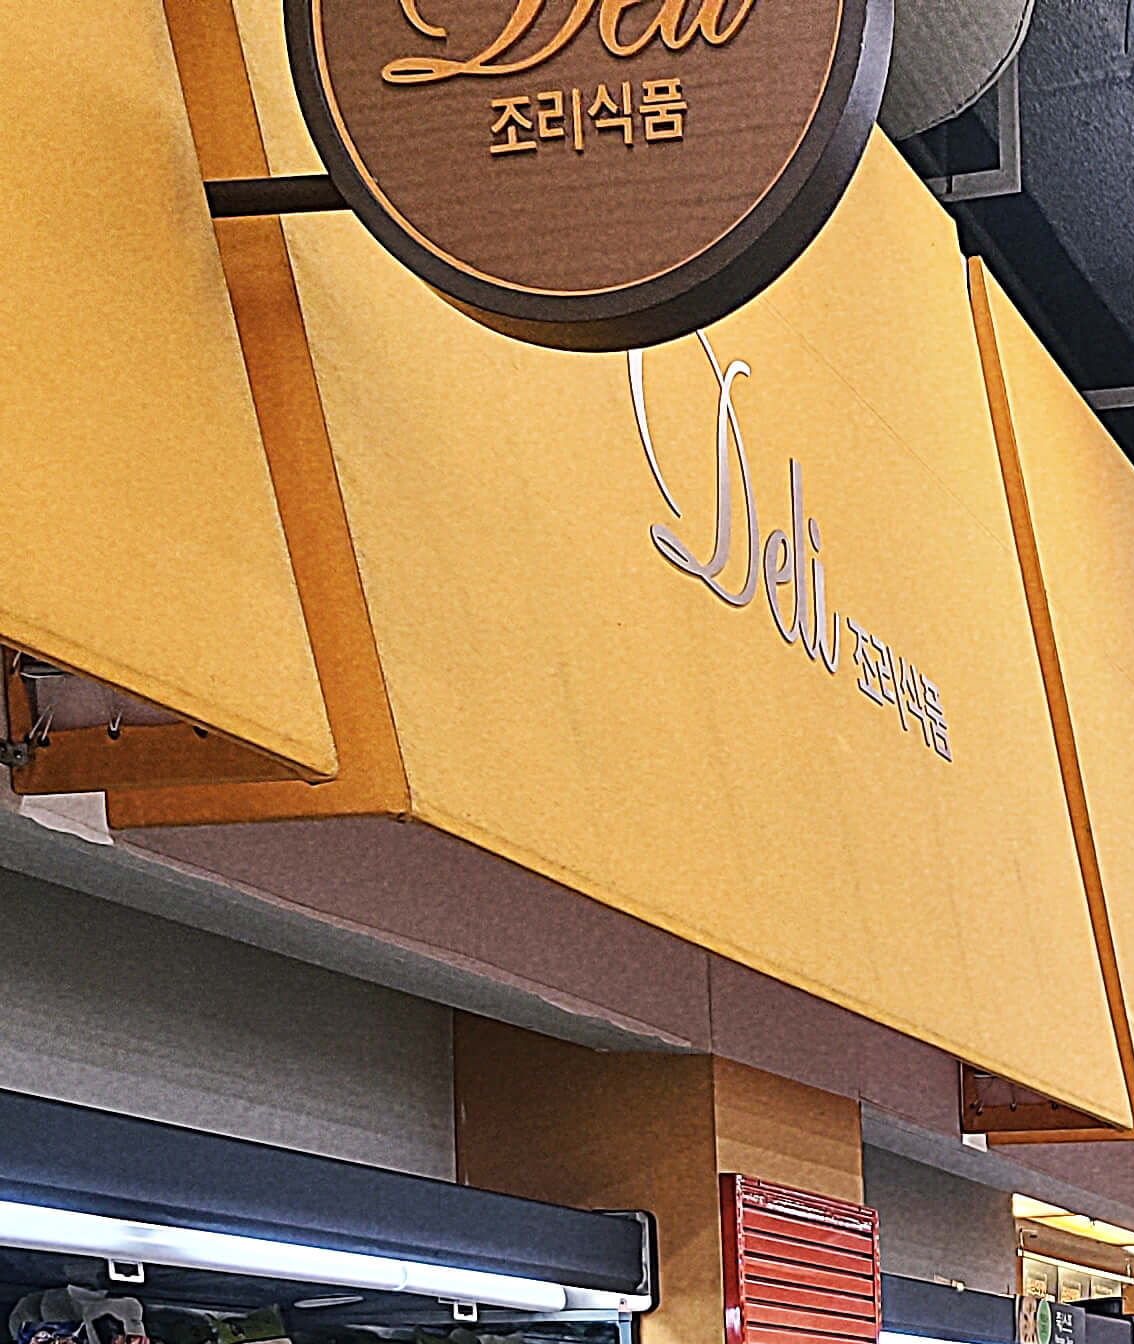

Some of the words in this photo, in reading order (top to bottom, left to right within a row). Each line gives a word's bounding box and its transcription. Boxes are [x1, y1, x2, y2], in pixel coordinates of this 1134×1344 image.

[490, 77, 688, 154] 조리식품
[627, 328, 839, 674] Deli
[846, 616, 953, 763] 조리식품
